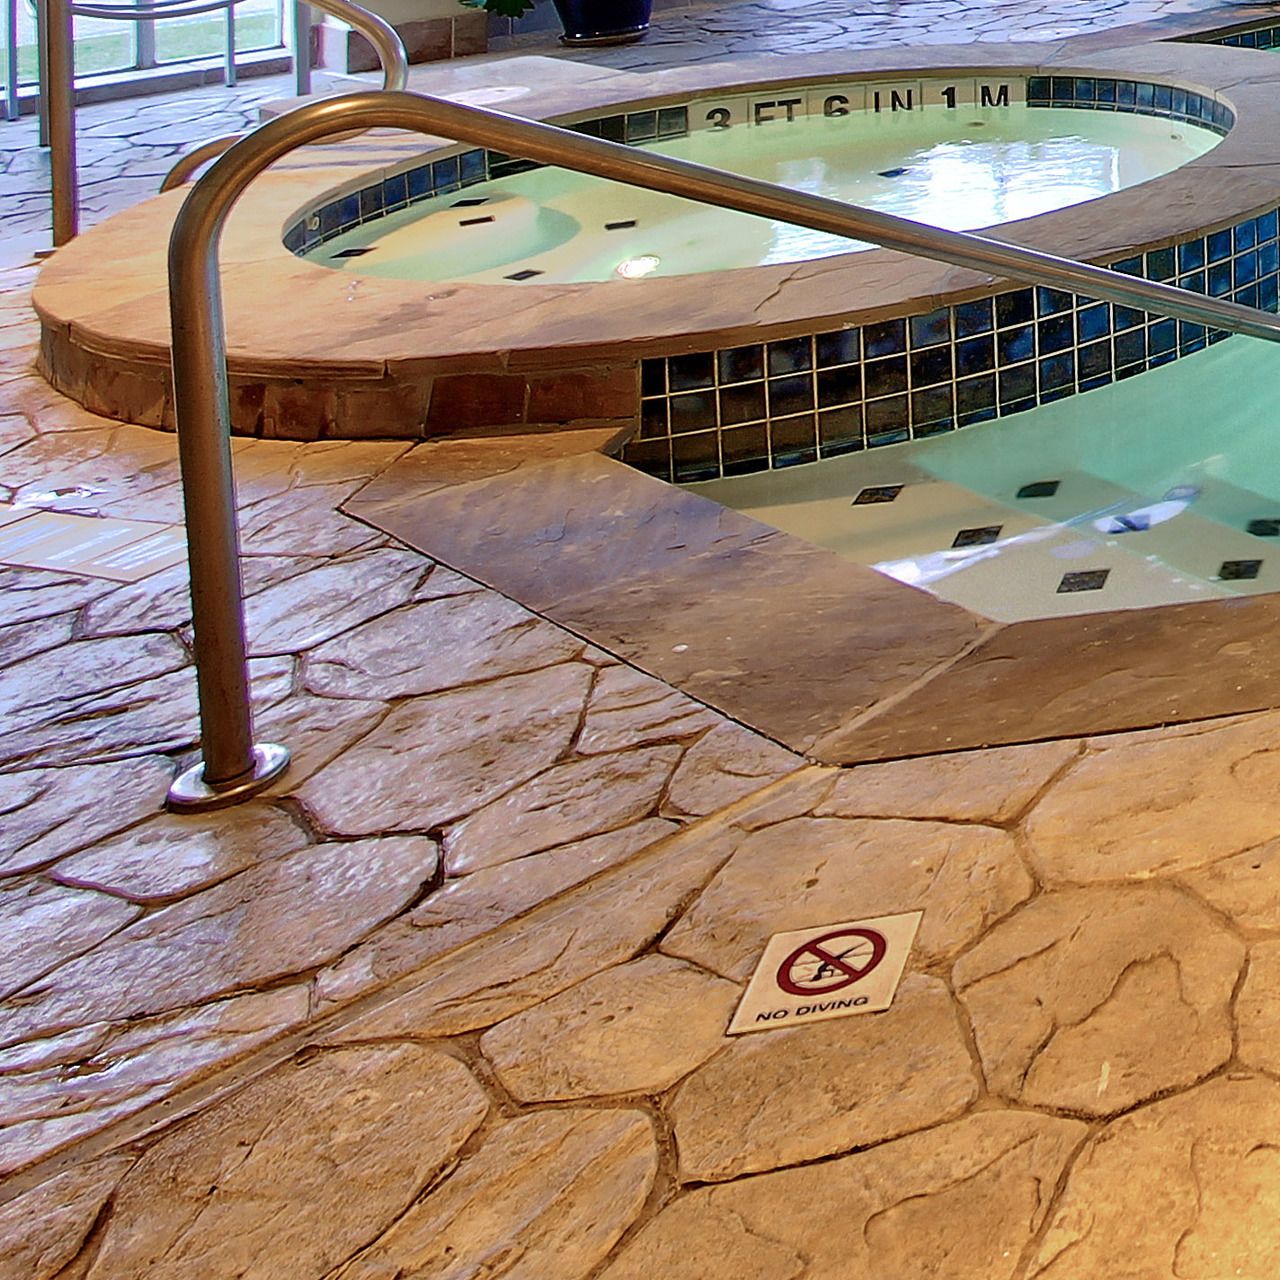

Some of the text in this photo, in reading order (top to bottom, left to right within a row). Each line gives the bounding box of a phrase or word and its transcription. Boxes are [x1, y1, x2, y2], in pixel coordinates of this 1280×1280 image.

[754, 98, 802, 126] FT
[823, 95, 849, 117] 6
[874, 89, 912, 113] IN
[941, 86, 956, 109] 1
[981, 84, 1008, 108] M
[755, 996, 870, 1023] NO DIVING
